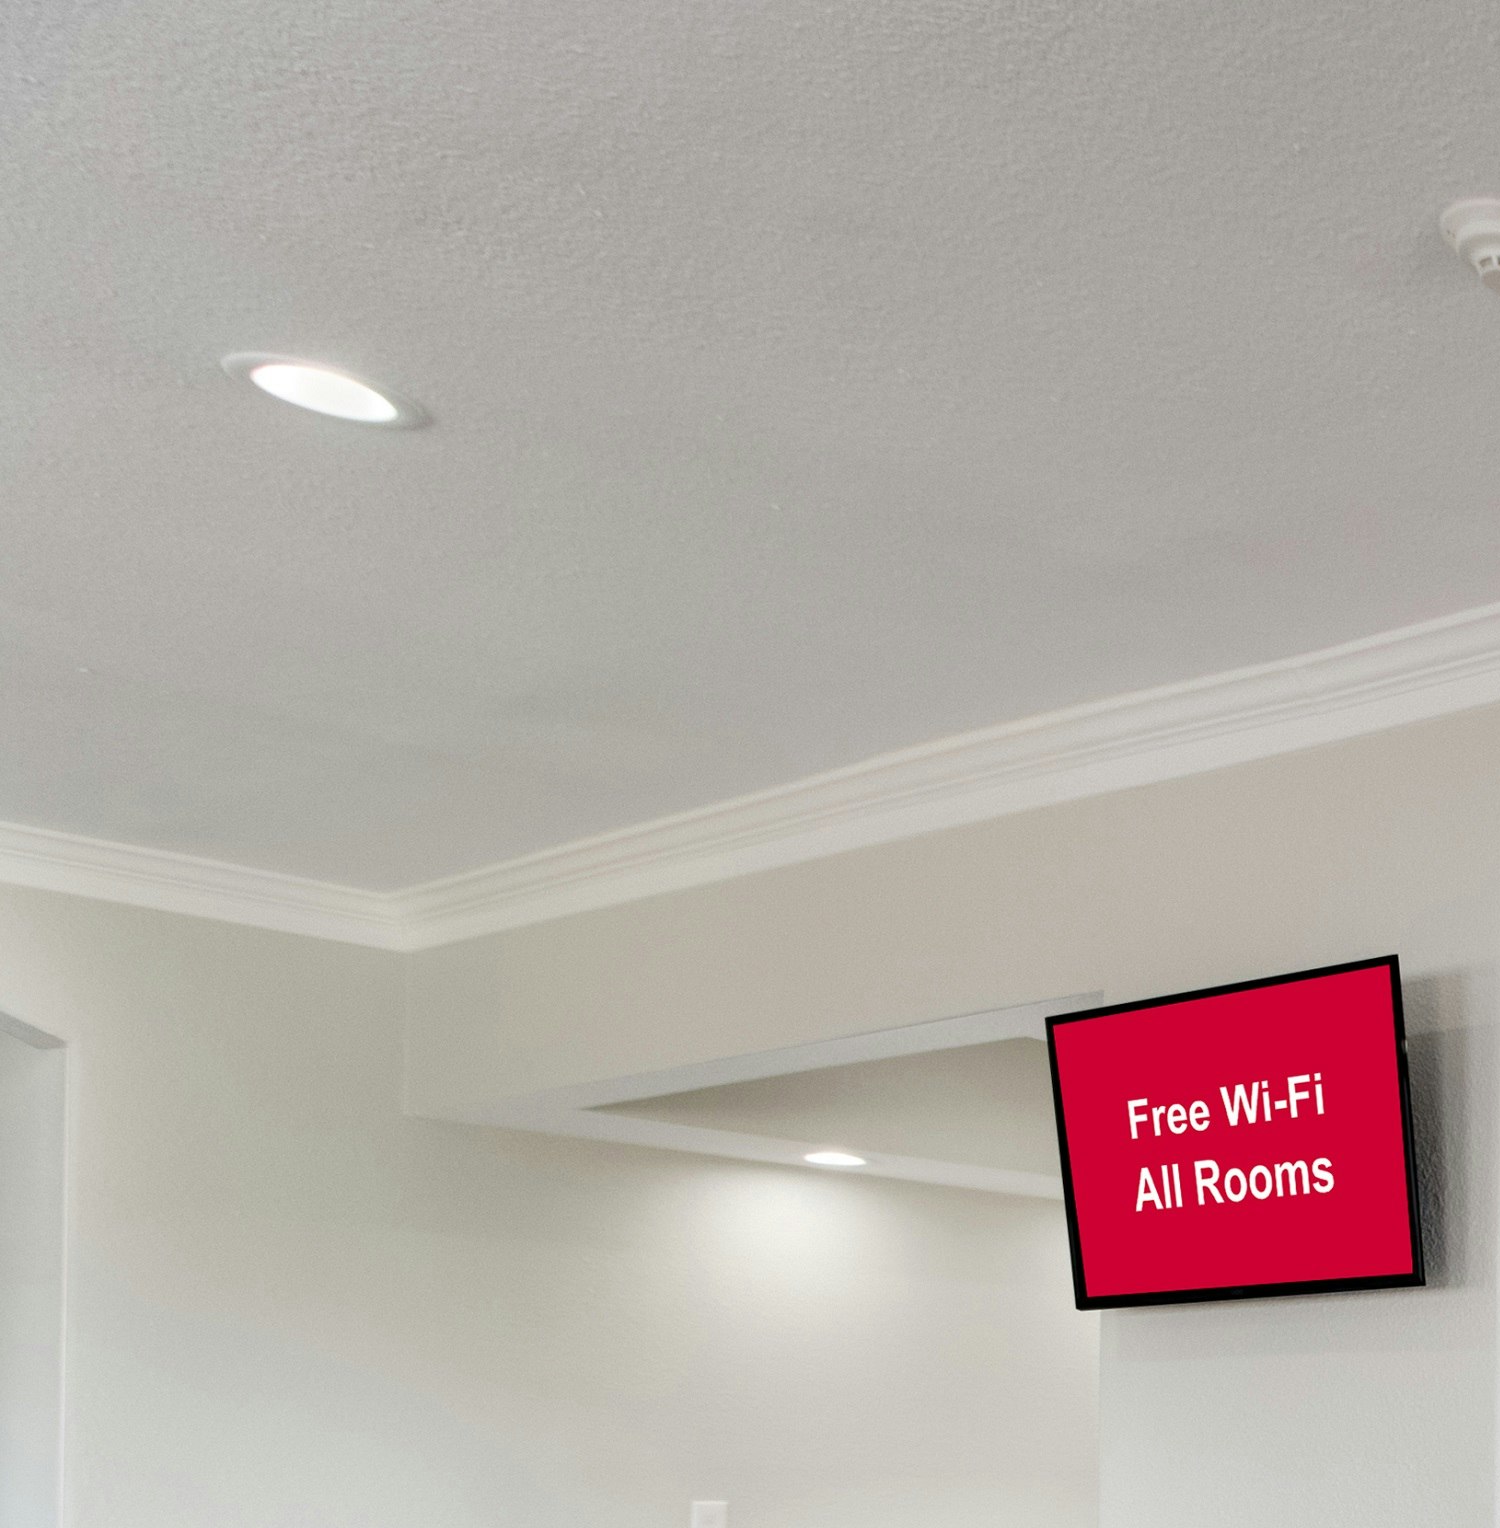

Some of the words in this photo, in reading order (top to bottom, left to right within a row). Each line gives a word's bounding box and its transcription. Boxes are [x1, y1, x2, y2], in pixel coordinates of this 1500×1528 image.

[1127, 1097, 1211, 1140] Free
[1219, 1072, 1325, 1127] Wi-Fi
[1135, 1163, 1184, 1212] All
[1193, 1157, 1335, 1206] Rooms
